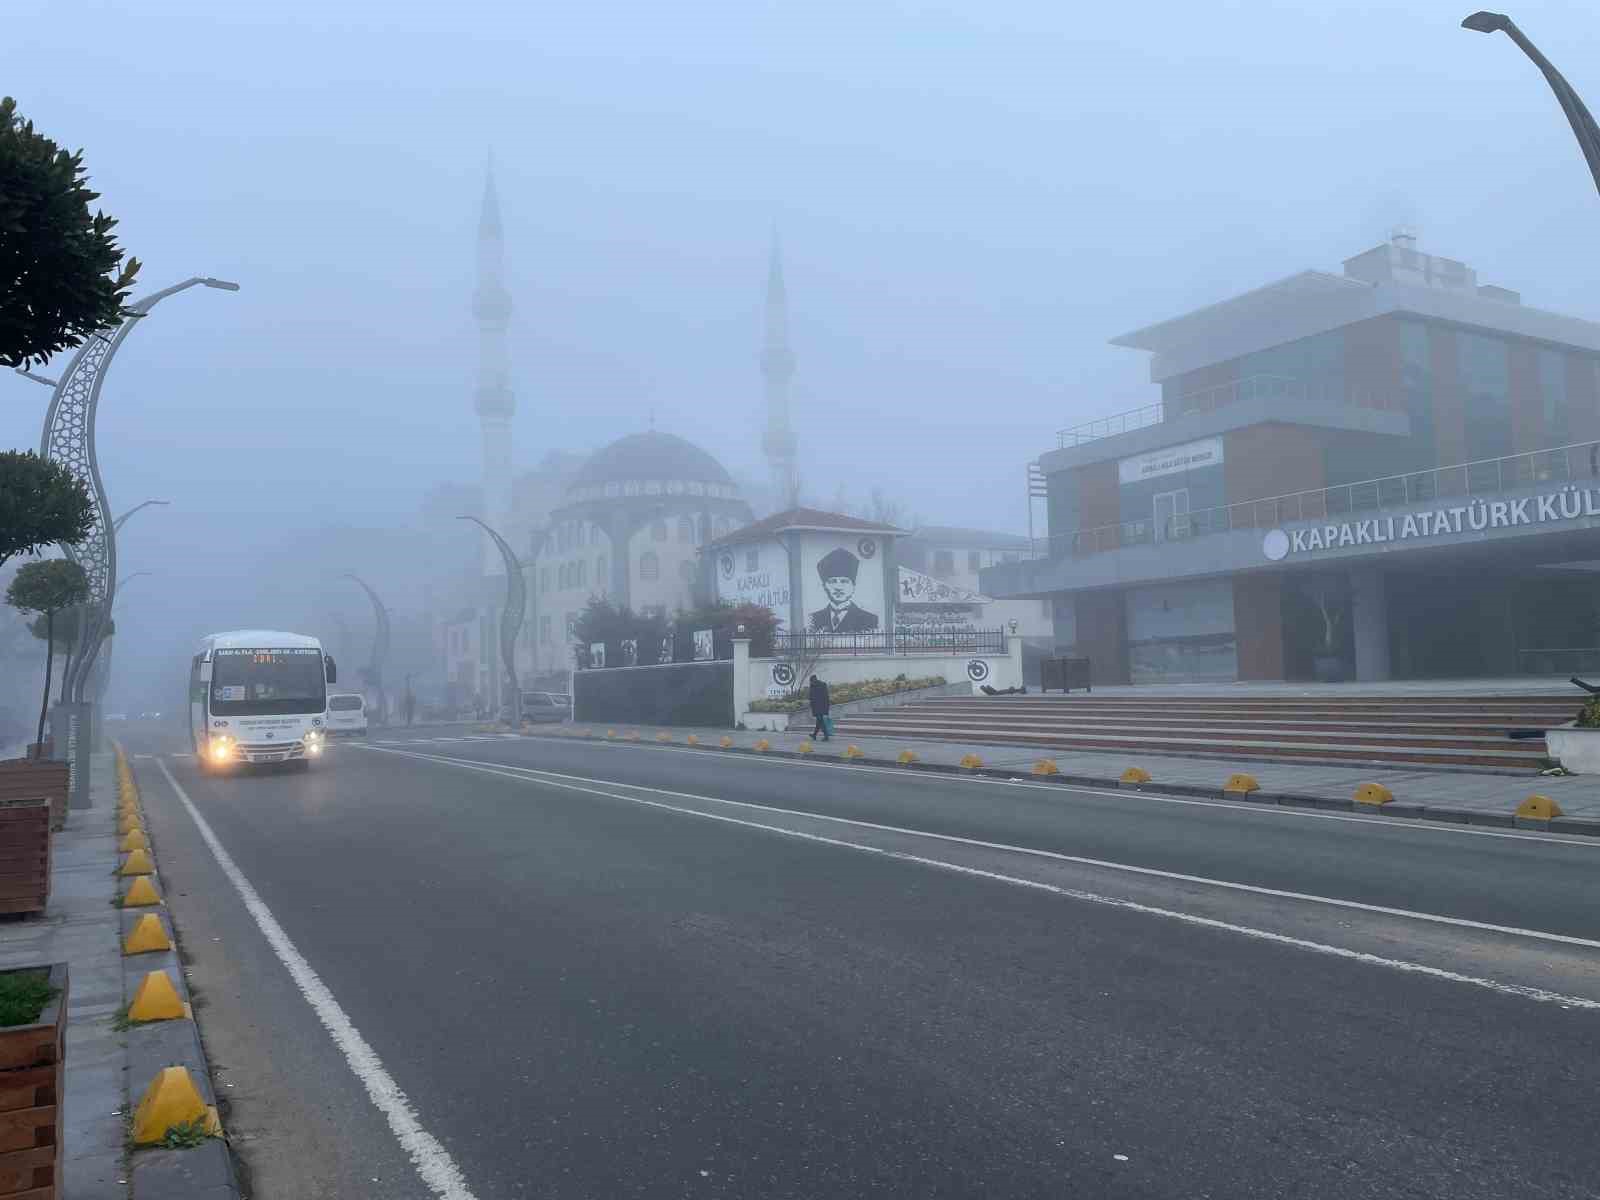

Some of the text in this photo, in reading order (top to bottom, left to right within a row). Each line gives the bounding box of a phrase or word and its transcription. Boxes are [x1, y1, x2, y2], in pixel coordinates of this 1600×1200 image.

[1292, 485, 1600, 552] KAPAKLI ATATÜRK KÜL
